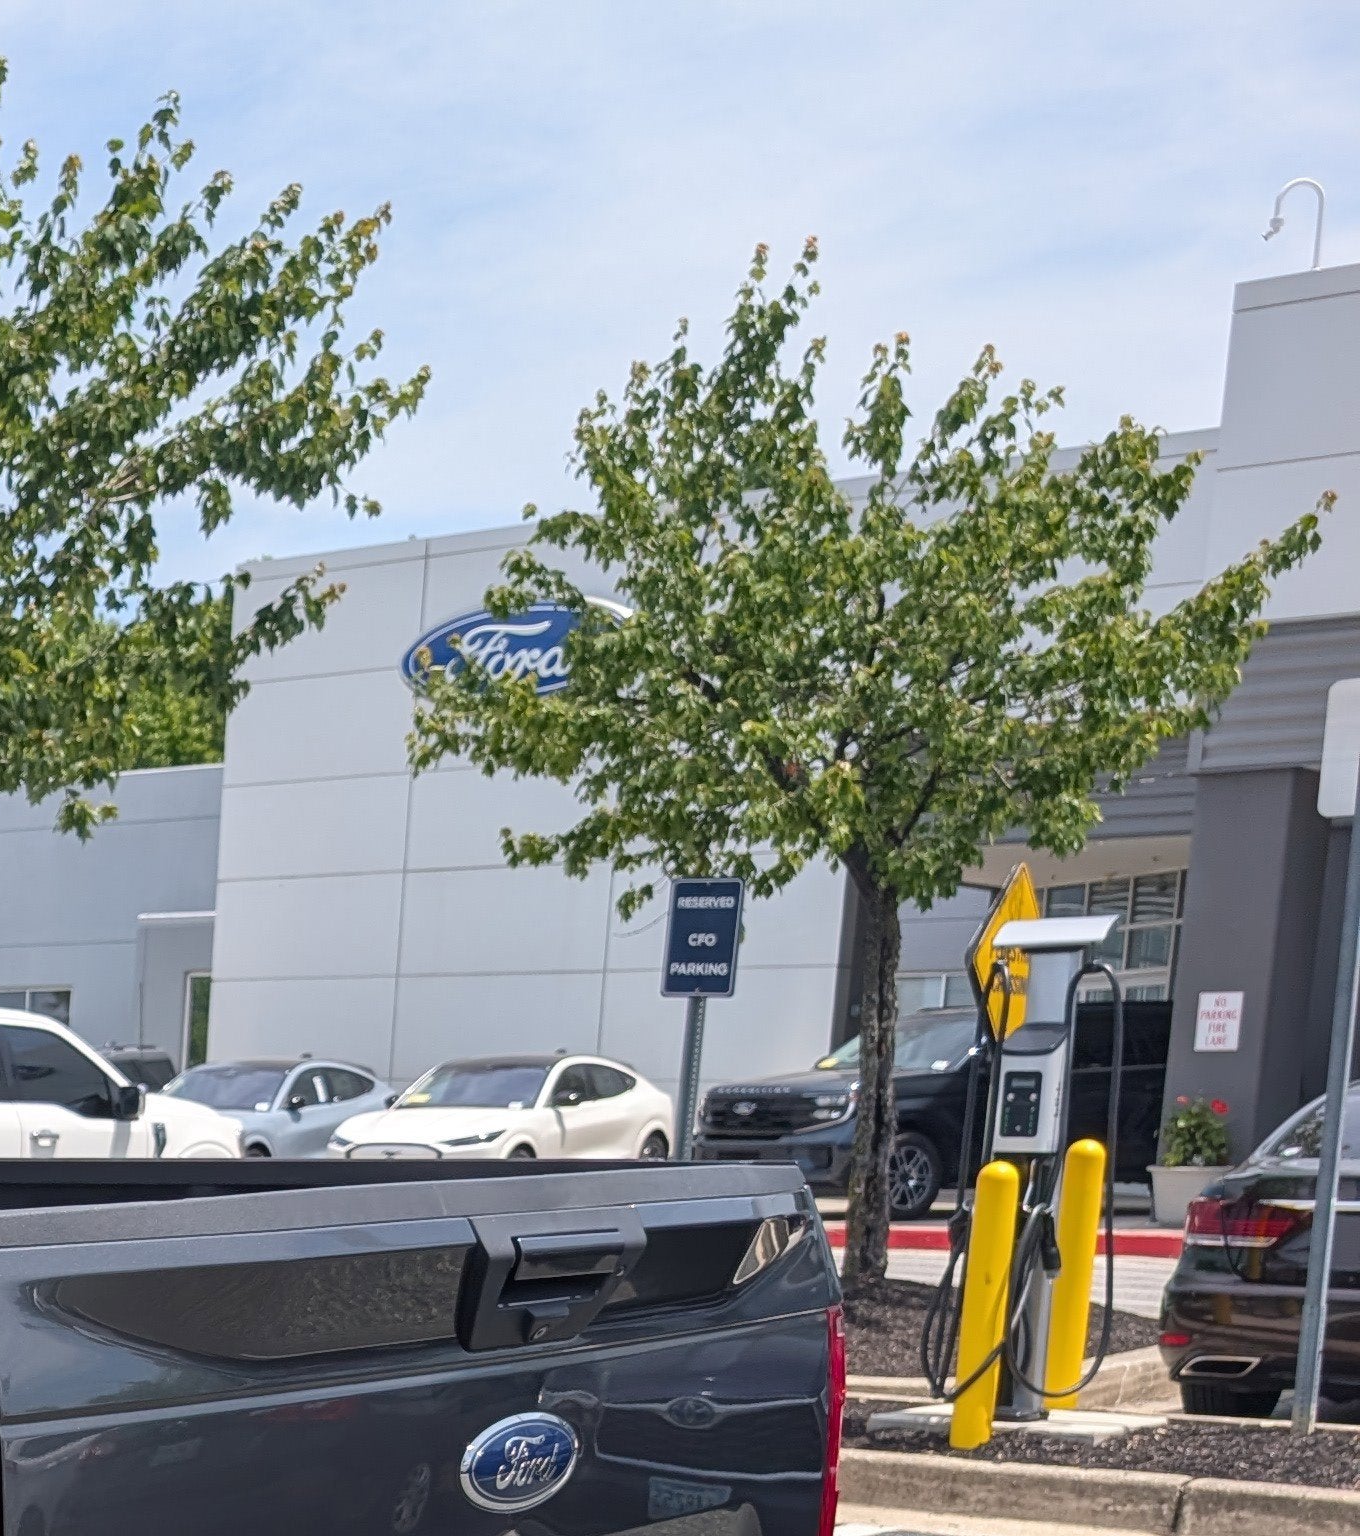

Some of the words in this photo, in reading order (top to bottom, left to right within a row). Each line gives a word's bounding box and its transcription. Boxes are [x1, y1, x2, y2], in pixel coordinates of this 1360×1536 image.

[677, 896, 735, 909] RESERVED
[688, 933, 717, 947] CFO
[670, 962, 728, 976] PARKING
[1214, 996, 1227, 1007] NO
[1200, 1009, 1237, 1020] PARKING
[496, 1434, 559, 1489] Ford
